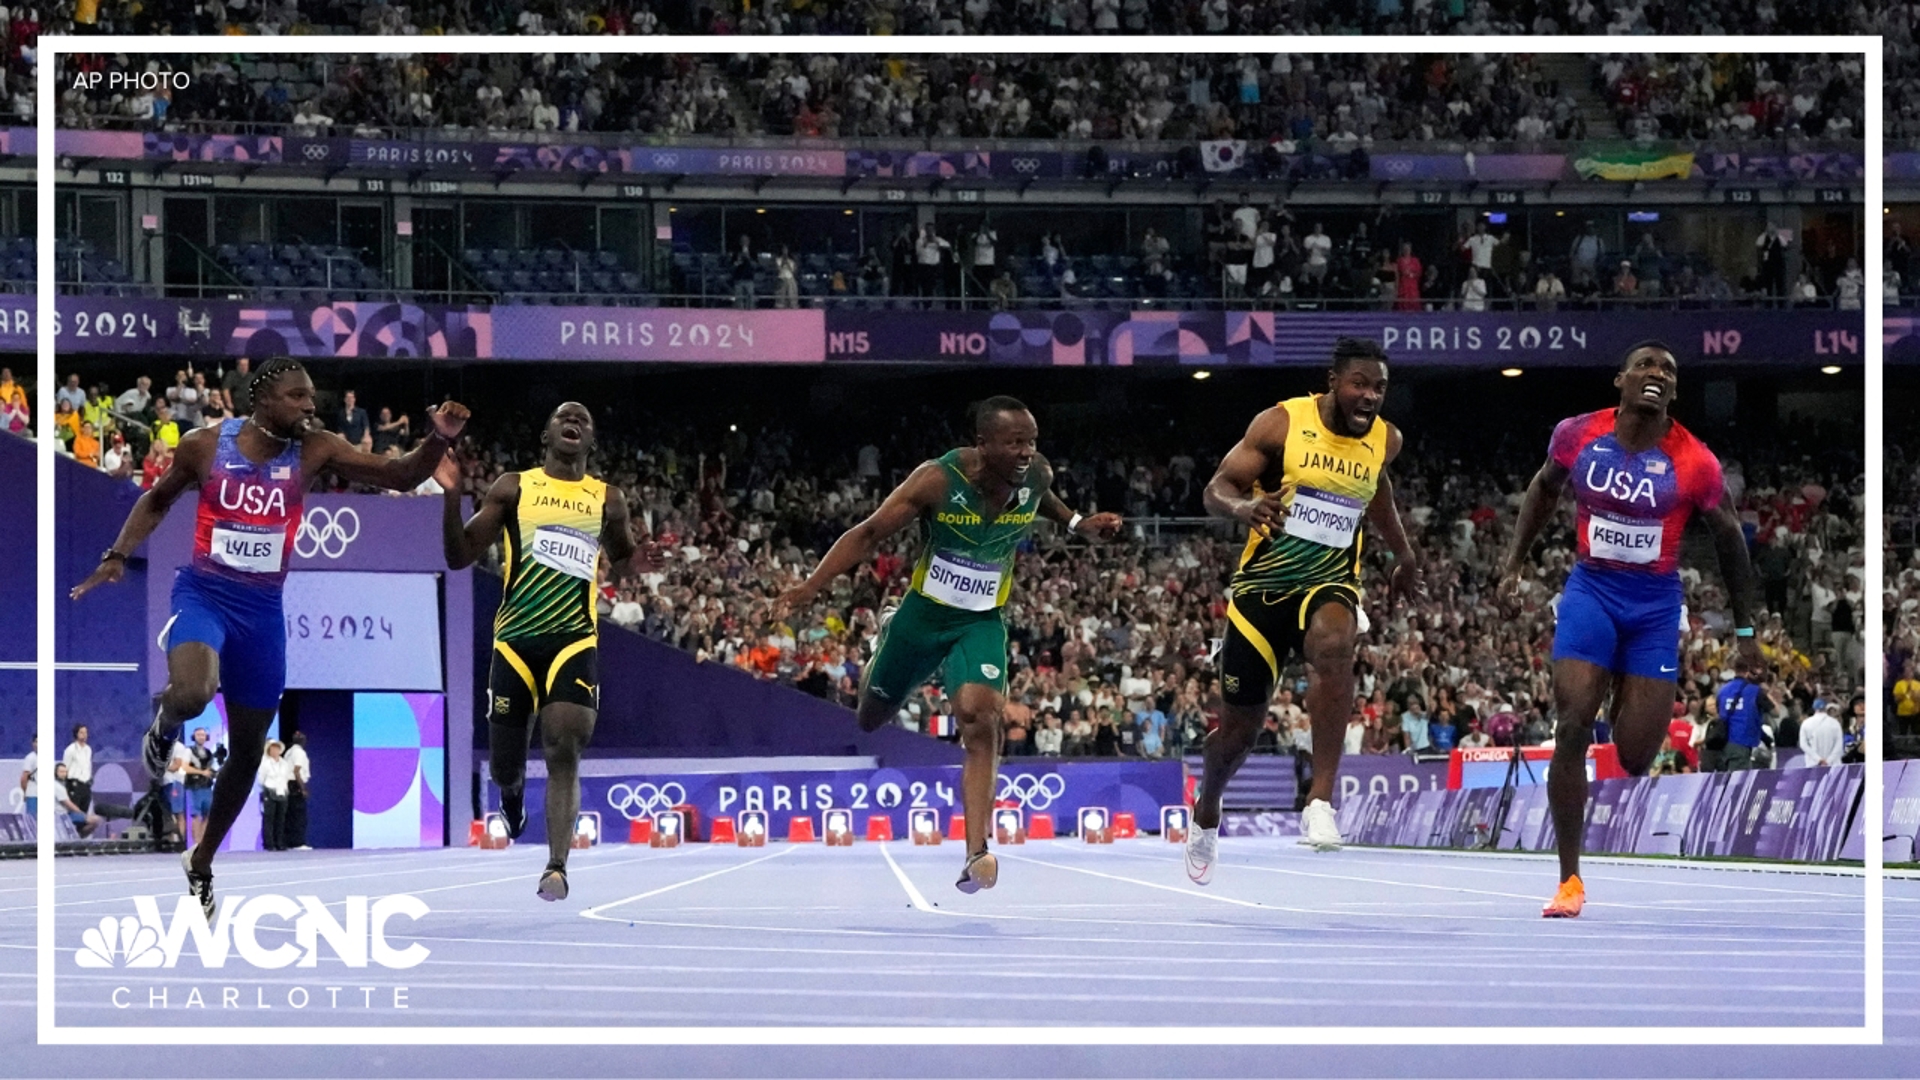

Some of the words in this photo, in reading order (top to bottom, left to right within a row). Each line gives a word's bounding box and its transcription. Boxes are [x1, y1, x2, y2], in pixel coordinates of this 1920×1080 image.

[425, 149, 473, 163] 2024
[780, 155, 828, 170] 2024
[105, 172, 124, 184] 132
[366, 180, 384, 191] 131
[624, 186, 643, 197] 130
[75, 311, 157, 337] 2024
[668, 322, 754, 348] 2024
[829, 331, 871, 354] N15
[940, 332, 987, 355] N10
[1496, 326, 1587, 350] 2024
[1703, 330, 1743, 355] N9
[1814, 330, 1859, 354] L14
[1299, 452, 1370, 484] JAMAICA
[1586, 460, 1657, 508] USA
[219, 479, 286, 517] USA
[532, 495, 593, 516] JAMAICA
[937, 512, 982, 525] SOUTH
[1292, 502, 1357, 533] THOMPSON
[226, 539, 272, 557] LYLES
[1593, 525, 1656, 548] KERLEY
[539, 539, 594, 569] SEVILLE
[929, 564, 997, 596] SIMBINE
[320, 615, 393, 640] 2024
[850, 780, 954, 809] 2024
